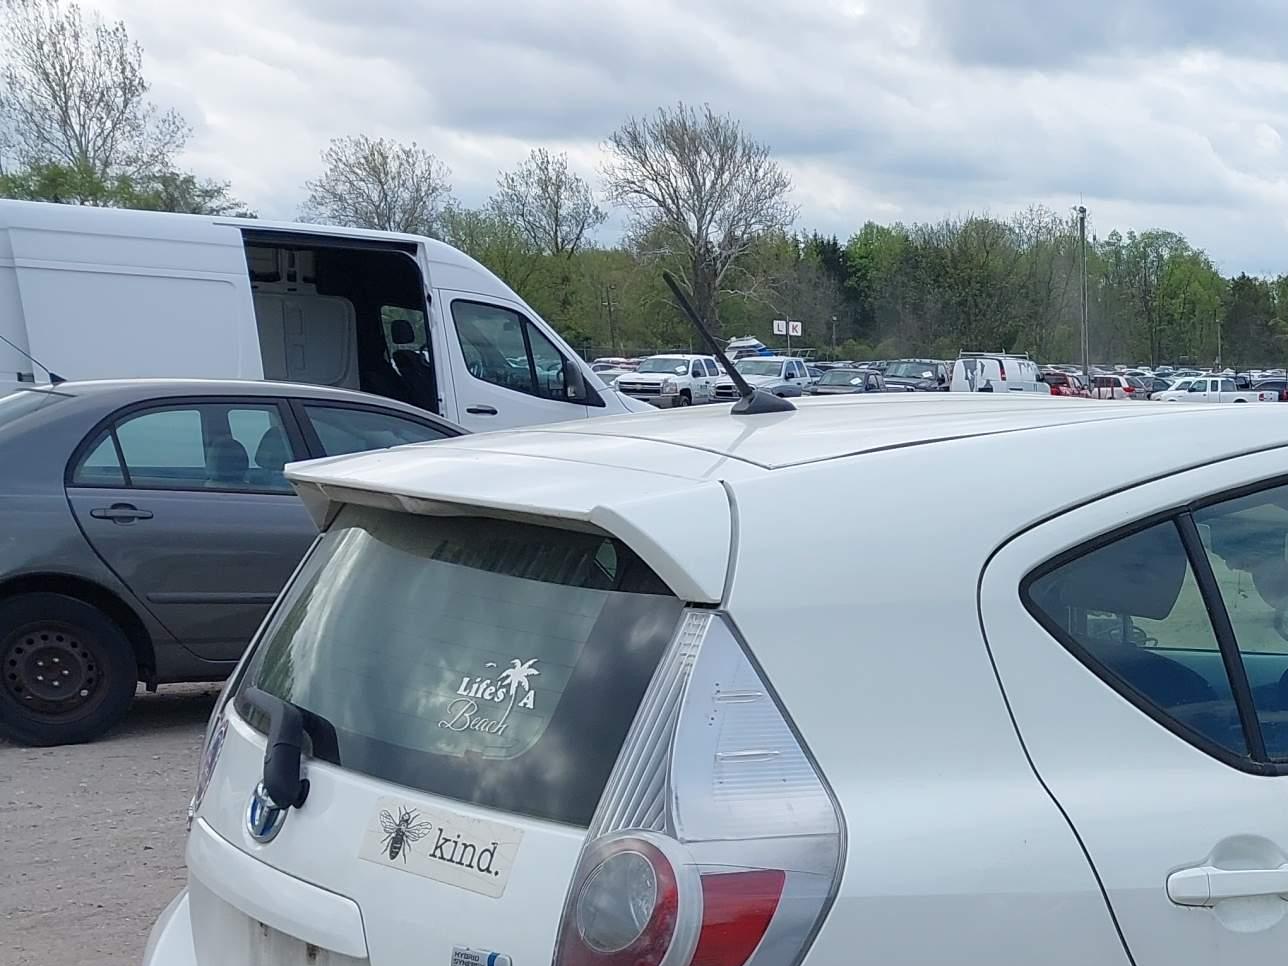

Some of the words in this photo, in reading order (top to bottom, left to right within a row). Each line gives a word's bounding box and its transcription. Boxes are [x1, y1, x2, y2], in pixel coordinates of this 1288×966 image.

[791, 324, 799, 334] K
[457, 677, 507, 702] Life's
[518, 690, 535, 709] A
[438, 698, 508, 735] Beach
[429, 827, 500, 877] kind.
[454, 951, 480, 962] HYBRID
